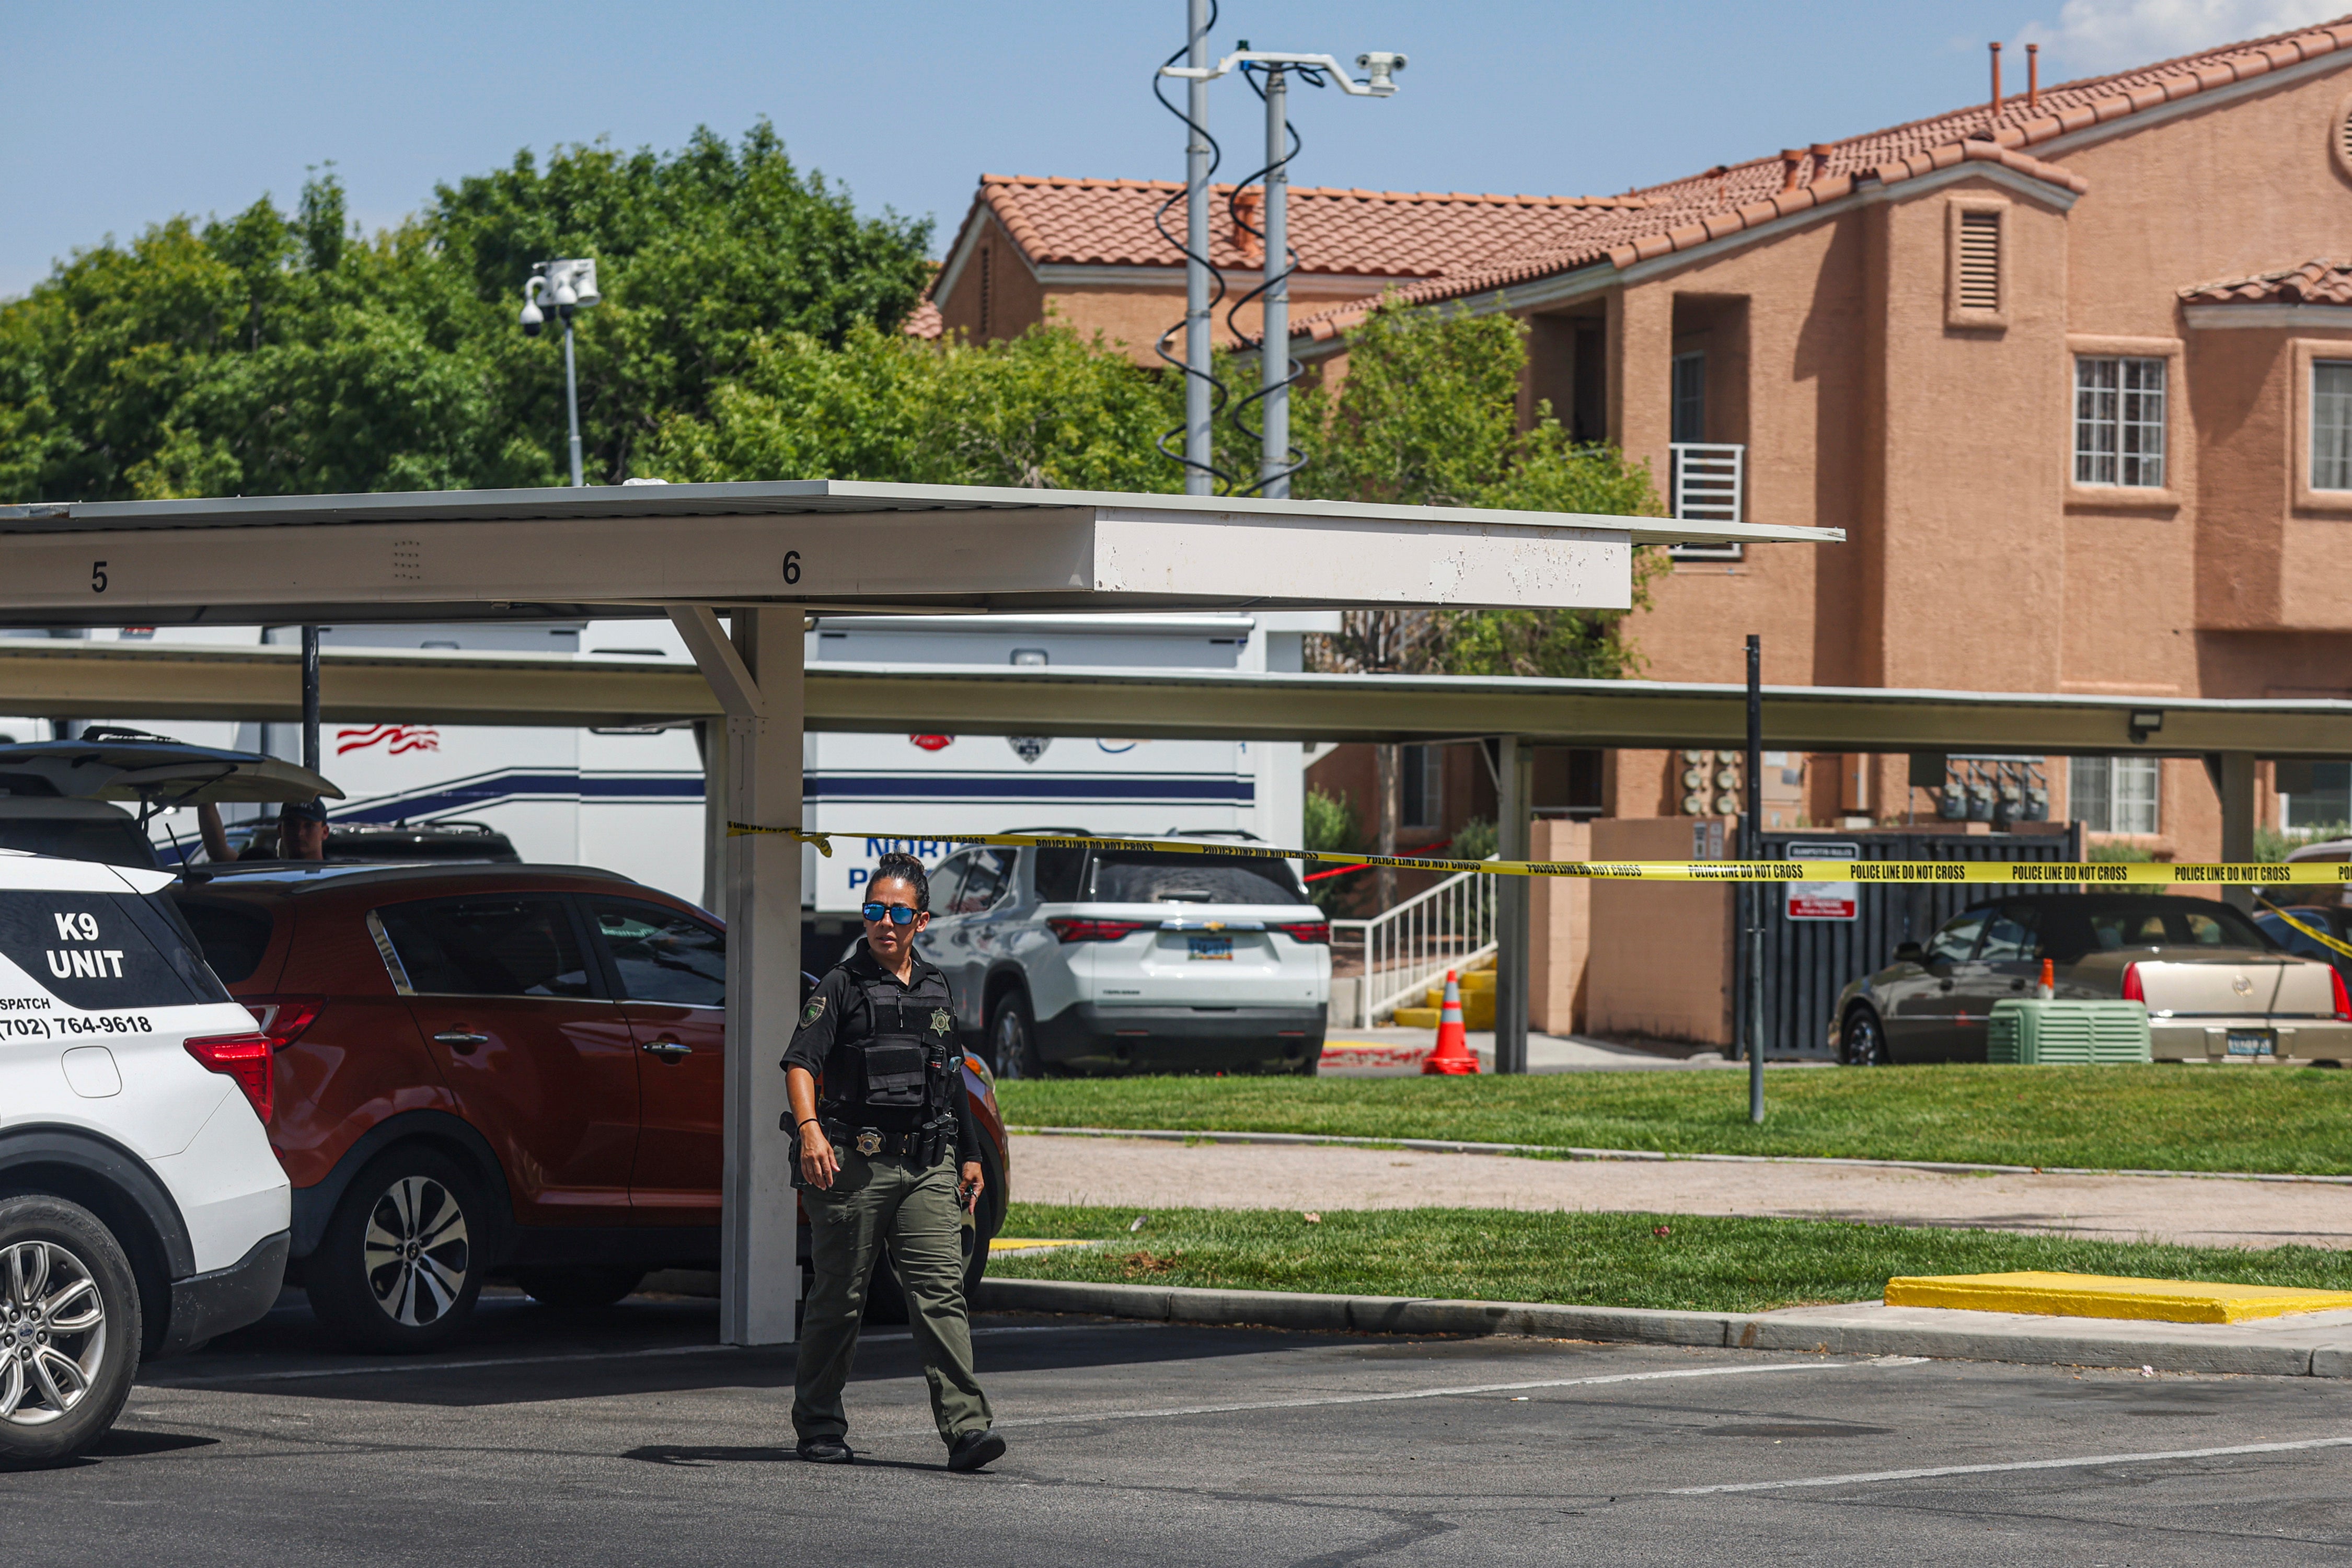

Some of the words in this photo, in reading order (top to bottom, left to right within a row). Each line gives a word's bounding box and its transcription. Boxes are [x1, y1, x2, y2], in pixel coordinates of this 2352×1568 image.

[783, 550, 801, 585] 6
[92, 561, 108, 593] 5
[1089, 841, 1102, 849] DO
[1104, 841, 1121, 850] NOT
[1124, 842, 1154, 851] CROSS
[1366, 856, 1396, 865] POLICE
[1398, 858, 1416, 867] LINE
[1418, 859, 1430, 868] DO
[1432, 859, 1448, 868] NOT
[1451, 860, 1481, 870] CROSS
[1526, 863, 1557, 874] POLICE
[1558, 864, 1577, 874] LINE
[1577, 864, 1591, 875] DO
[1593, 864, 1610, 875] NOT
[1611, 864, 1642, 877] CROSS
[1688, 864, 1719, 878] POLICE
[1720, 864, 1739, 878] LINE
[1740, 864, 1751, 878] DO
[1754, 864, 1771, 878] NOT
[1774, 864, 1803, 879] CROSS
[1850, 864, 1881, 879] POLICE
[1882, 864, 1900, 879] LINE
[1903, 865, 1914, 879] DO
[1916, 865, 1933, 879] NOT
[1935, 865, 1965, 880] CROSS
[2012, 866, 2042, 880] POLICE
[2044, 866, 2062, 880] LINE
[2065, 866, 2076, 880] DO
[2078, 866, 2096, 880] NOT
[2097, 866, 2127, 880] CROSS
[2175, 866, 2205, 880] POLICE
[2207, 866, 2225, 881] LINE
[2227, 866, 2239, 881] DO
[2241, 866, 2258, 881] NOT
[2261, 866, 2290, 881] CROSS
[54, 913, 99, 941] K9
[46, 950, 124, 978] UNIT
[52, 1016, 152, 1034] 764-9618
